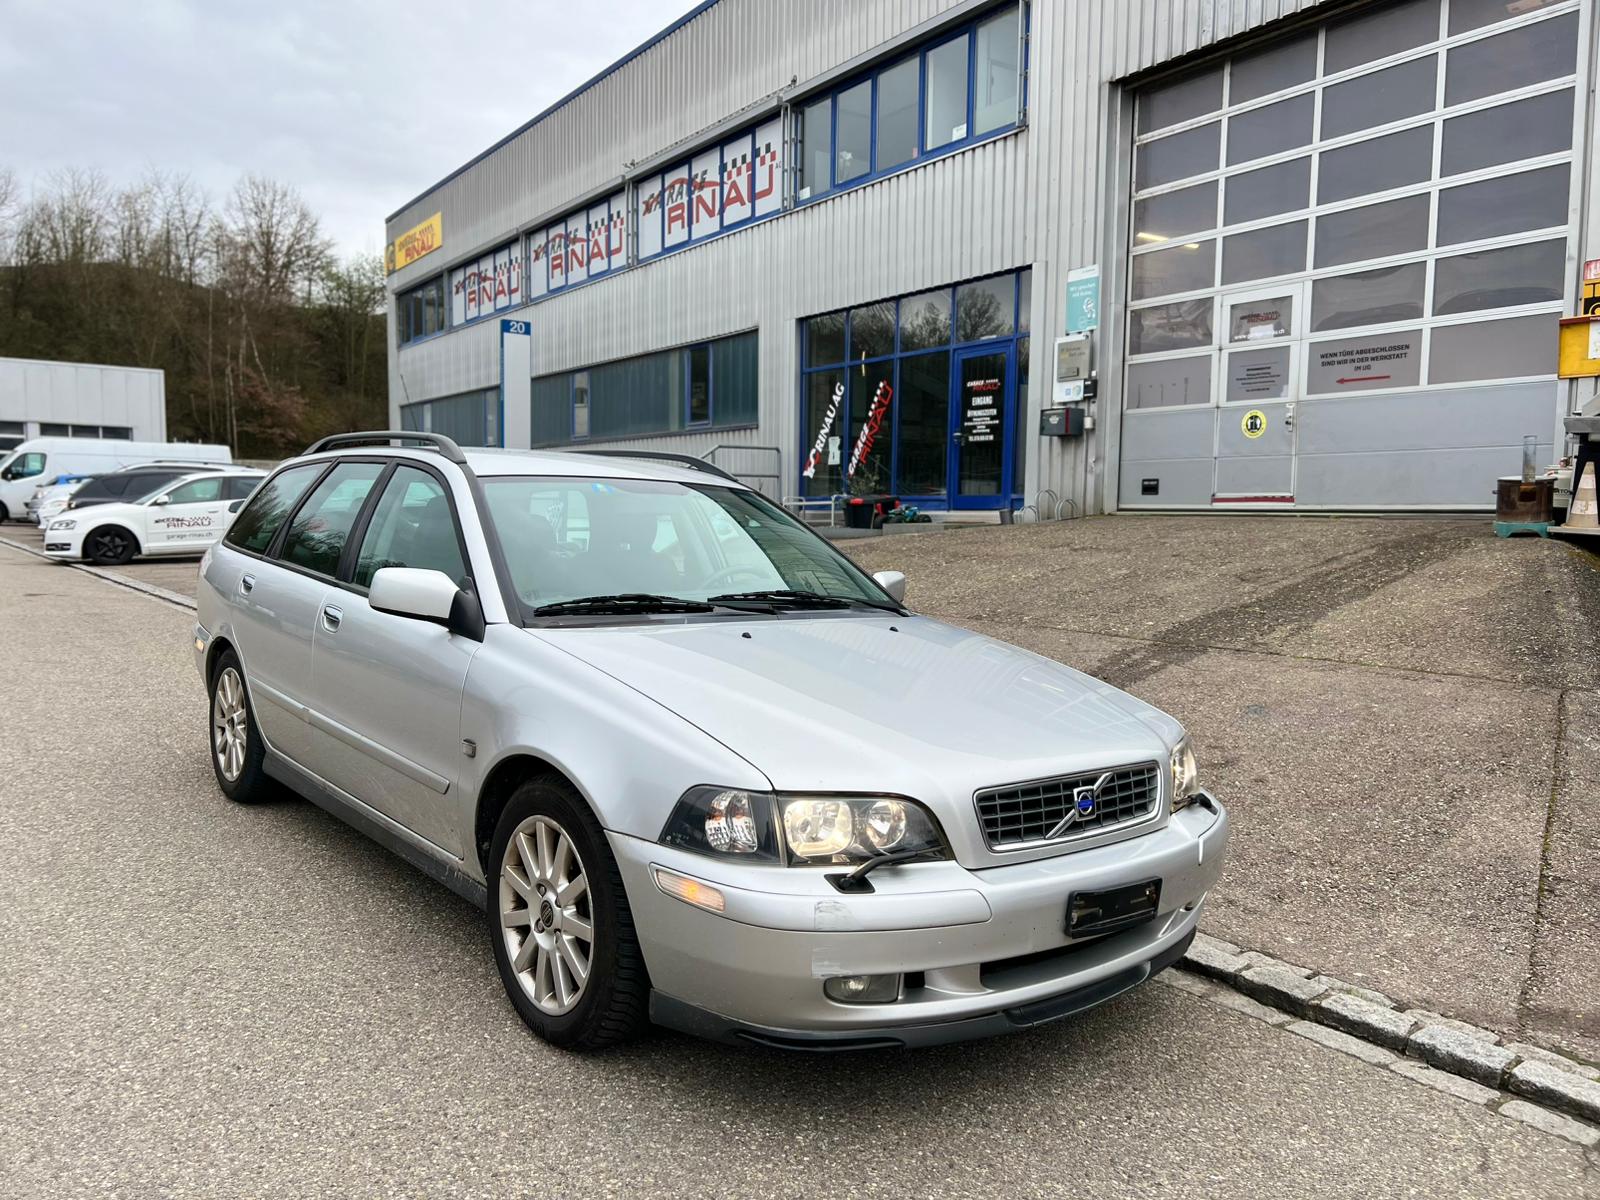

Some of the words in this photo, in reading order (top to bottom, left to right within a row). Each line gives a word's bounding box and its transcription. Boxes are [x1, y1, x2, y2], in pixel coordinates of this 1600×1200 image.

[667, 163, 774, 235] RINAU
[551, 228, 623, 279] RINAU
[510, 321, 525, 333] 20
[1320, 351, 1338, 359] WENN
[1339, 349, 1354, 357] TÜRE
[1355, 344, 1410, 355] ABGESCHLOSSEN
[1371, 352, 1408, 361] WERKSTATT
[832, 382, 845, 407] AG
[860, 381, 894, 465] RINAU
[847, 422, 869, 476] GARAGE
[166, 517, 212, 528] RINAU
